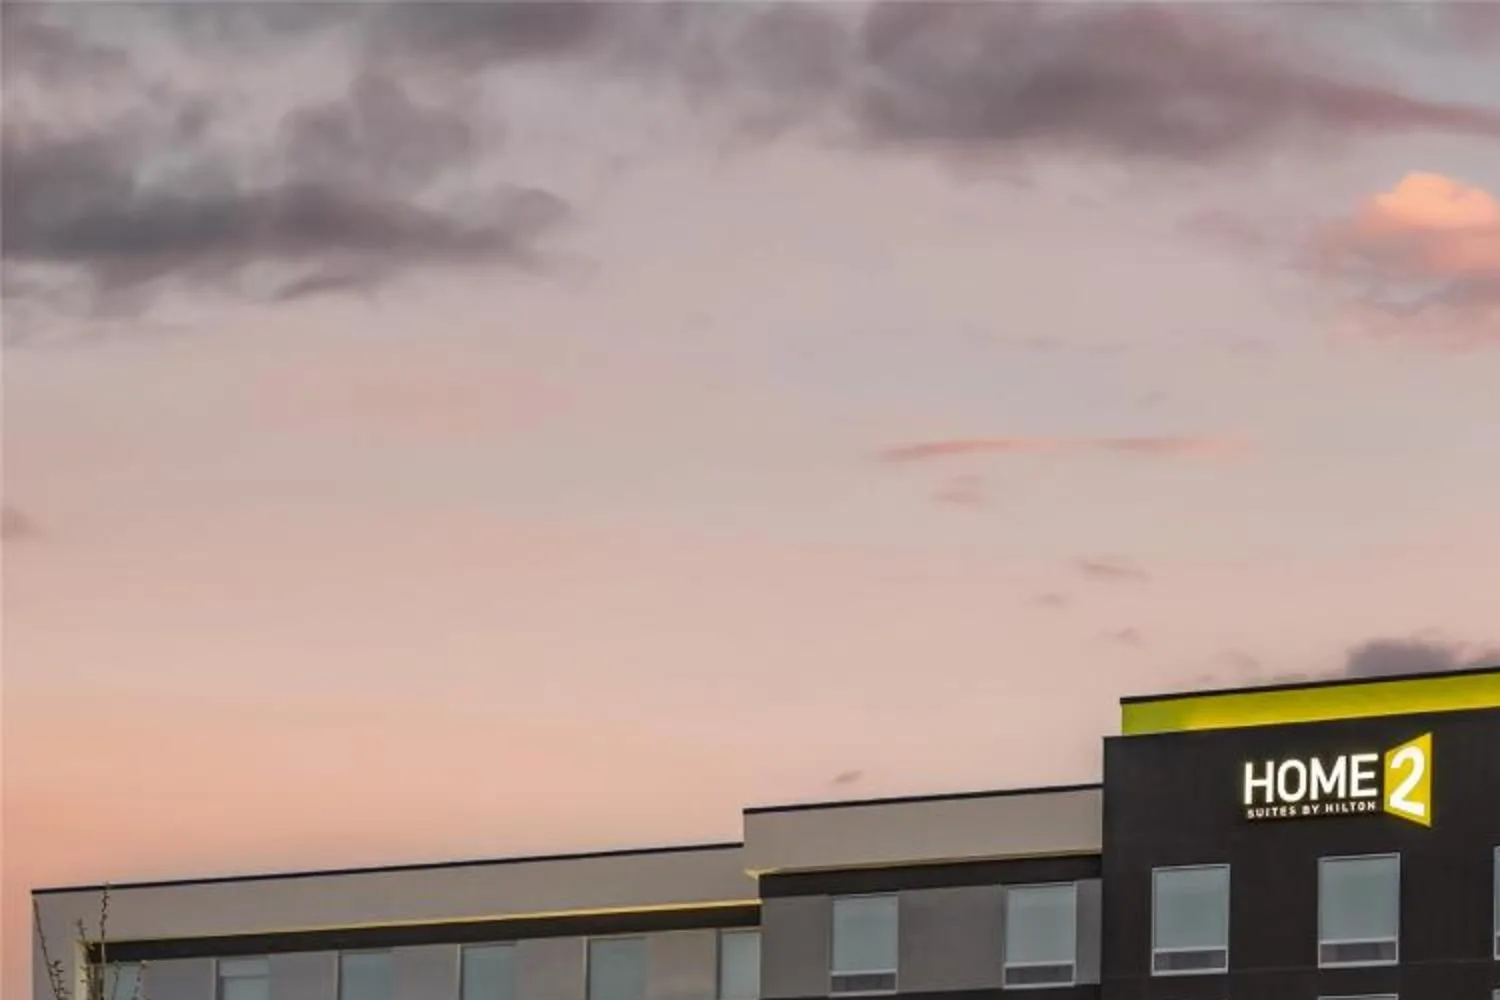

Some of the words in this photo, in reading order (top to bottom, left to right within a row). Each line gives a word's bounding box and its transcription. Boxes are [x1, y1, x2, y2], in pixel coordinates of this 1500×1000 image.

[1244, 753, 1379, 804] HOME
[1390, 745, 1425, 817] 2
[1247, 806, 1297, 818] SUITES
[1301, 804, 1320, 815] BY
[1325, 801, 1377, 813] HILTON
